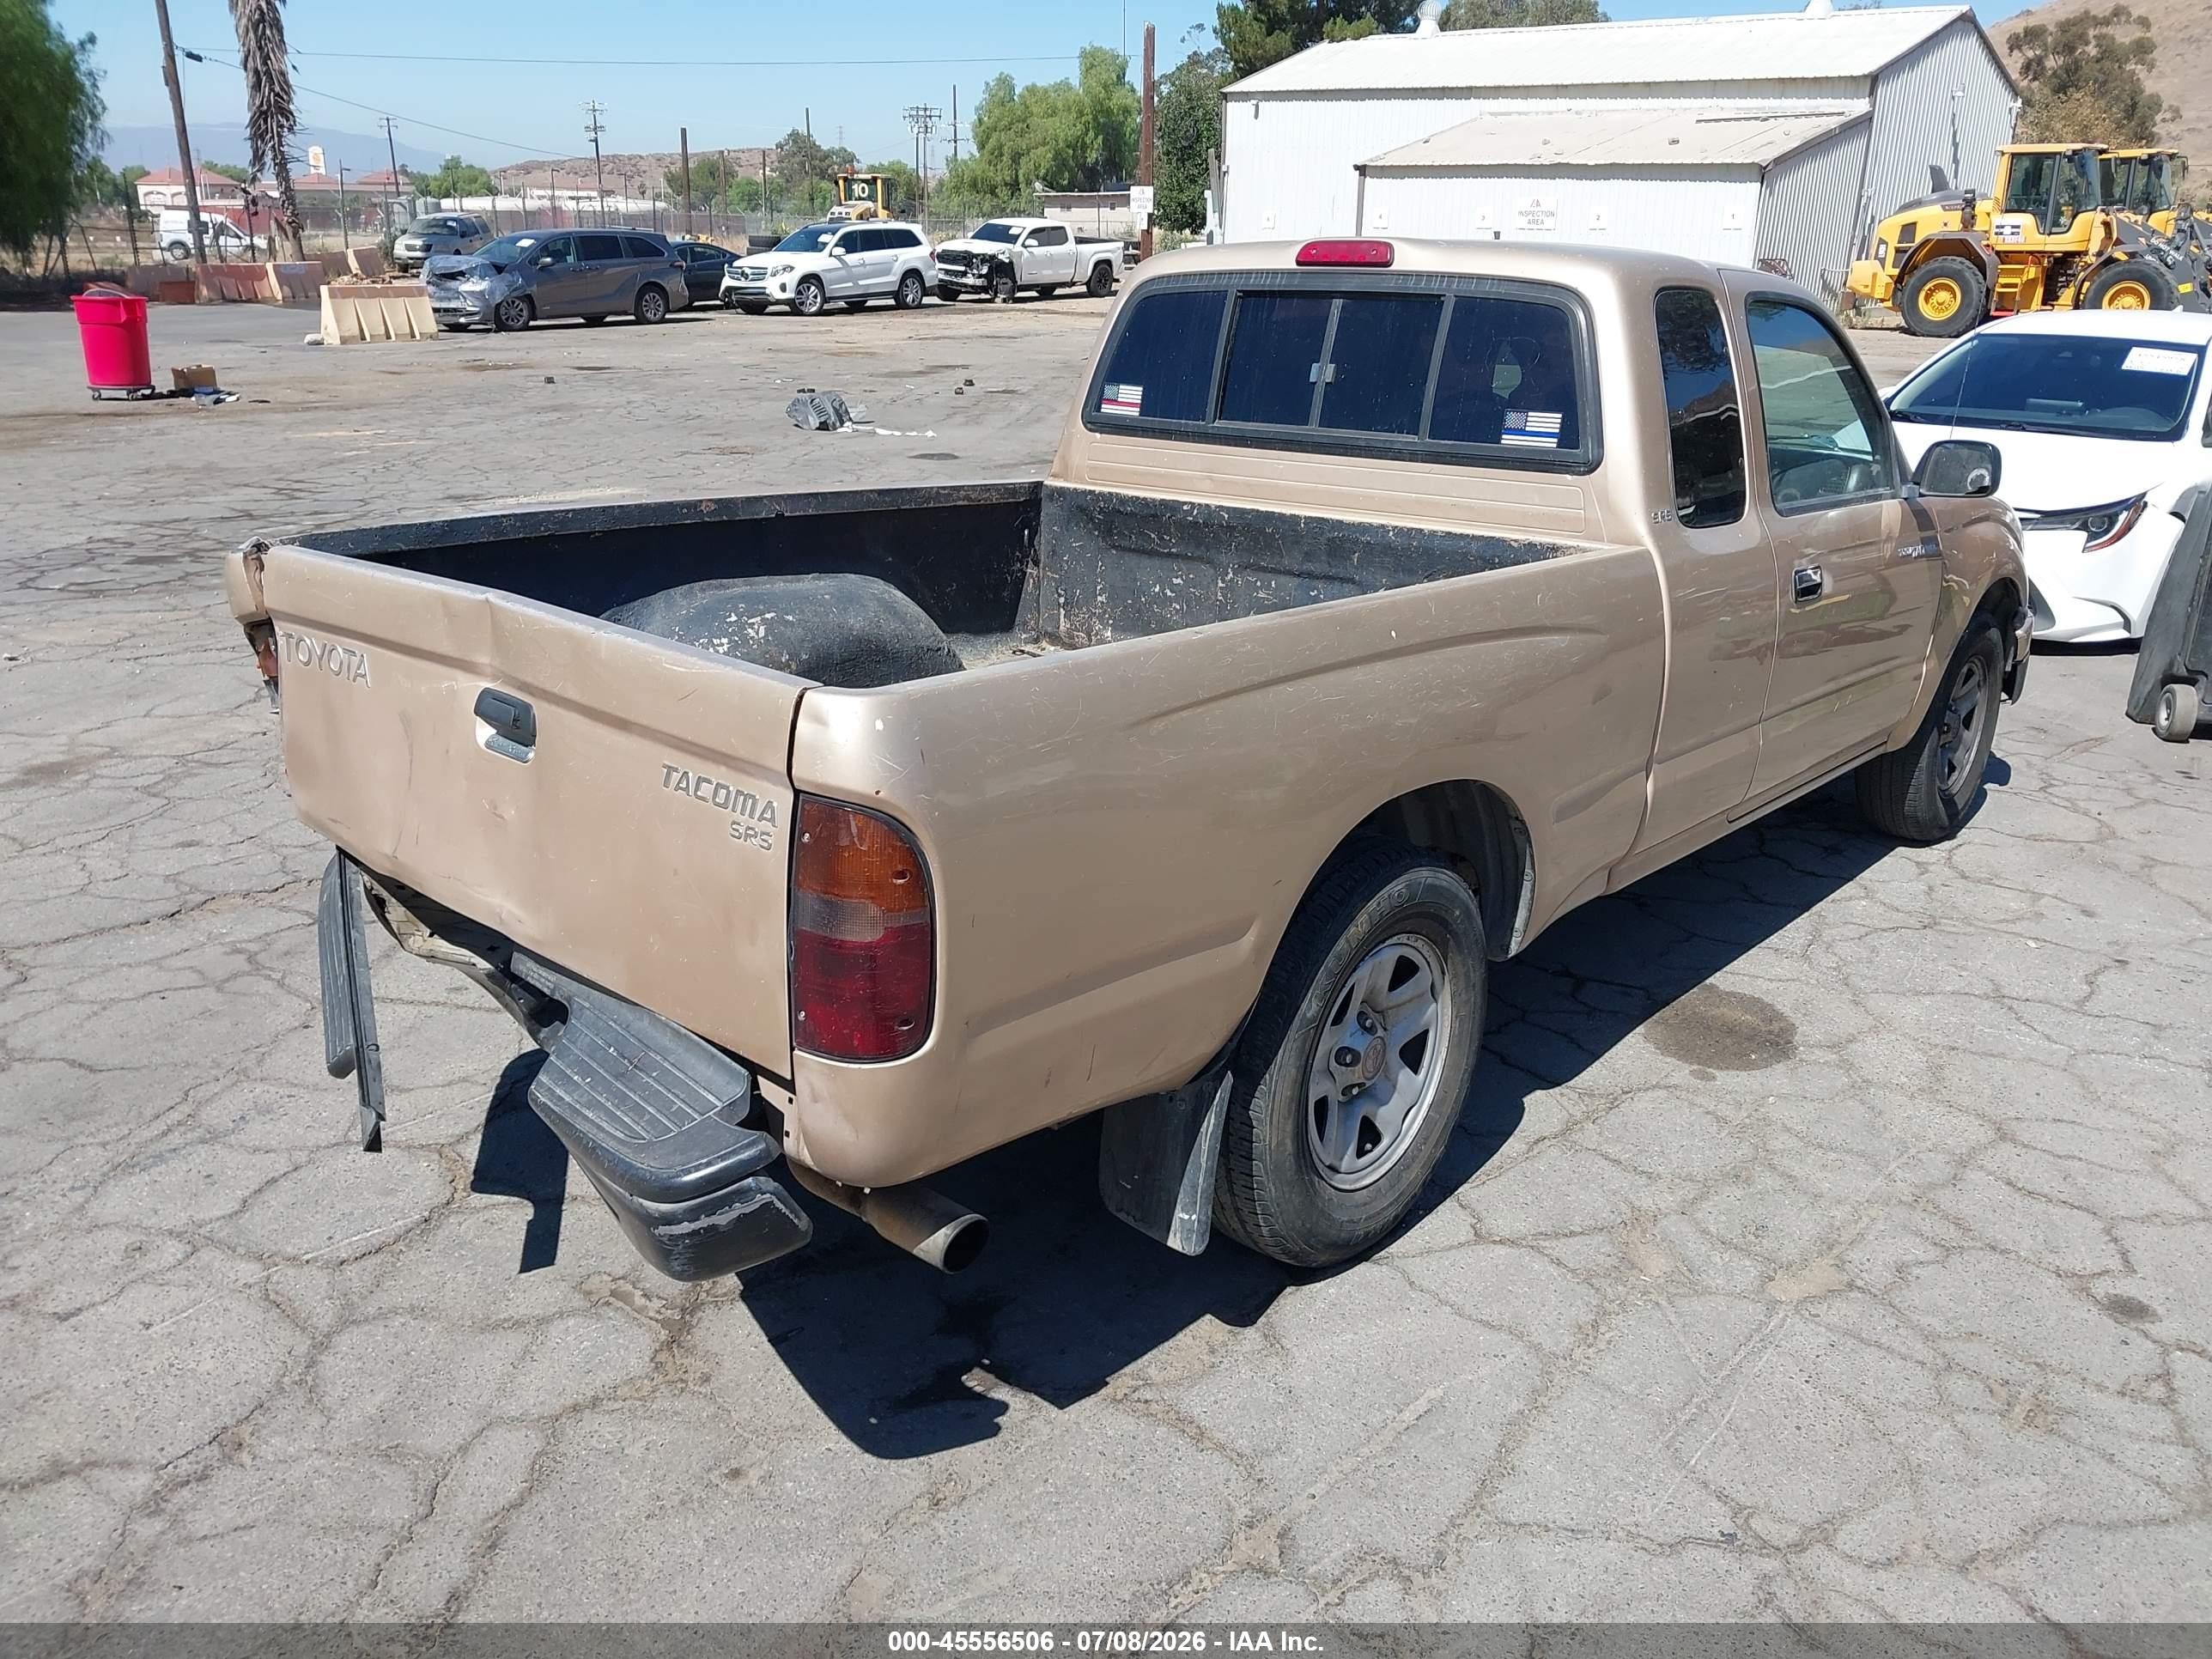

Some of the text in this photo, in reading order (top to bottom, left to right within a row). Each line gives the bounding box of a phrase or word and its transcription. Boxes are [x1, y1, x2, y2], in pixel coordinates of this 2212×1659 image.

[852, 183, 868, 198] 10
[1517, 210, 1555, 218] INSPECTION
[2150, 237, 2160, 246] DO
[2158, 242, 2171, 252] NOT
[2169, 250, 2185, 262] WALK
[278, 631, 371, 689] TOYOTA
[661, 762, 779, 829] TACOMA
